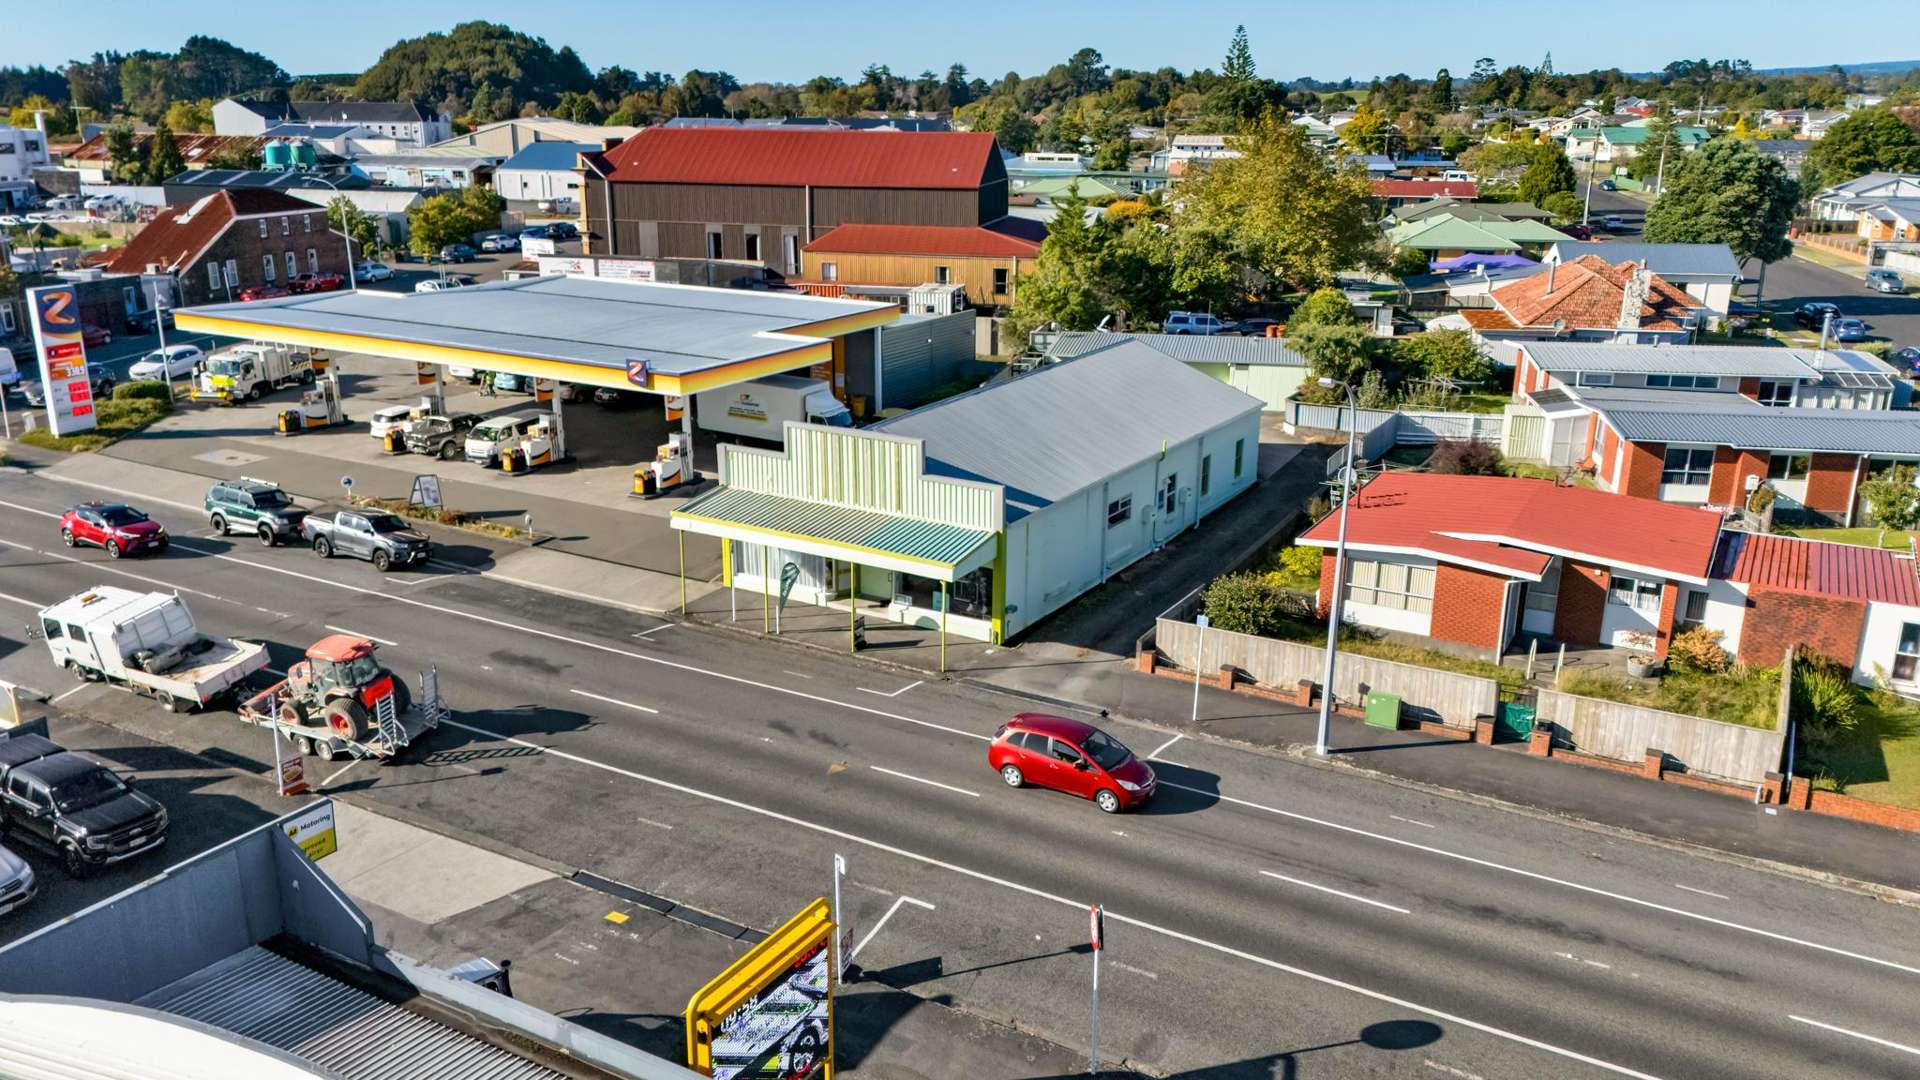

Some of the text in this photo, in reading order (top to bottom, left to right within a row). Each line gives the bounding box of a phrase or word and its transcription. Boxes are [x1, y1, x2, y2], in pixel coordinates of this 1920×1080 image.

[43, 291, 75, 324] Z
[629, 361, 643, 381] Z
[300, 814, 331, 831] Motoring
